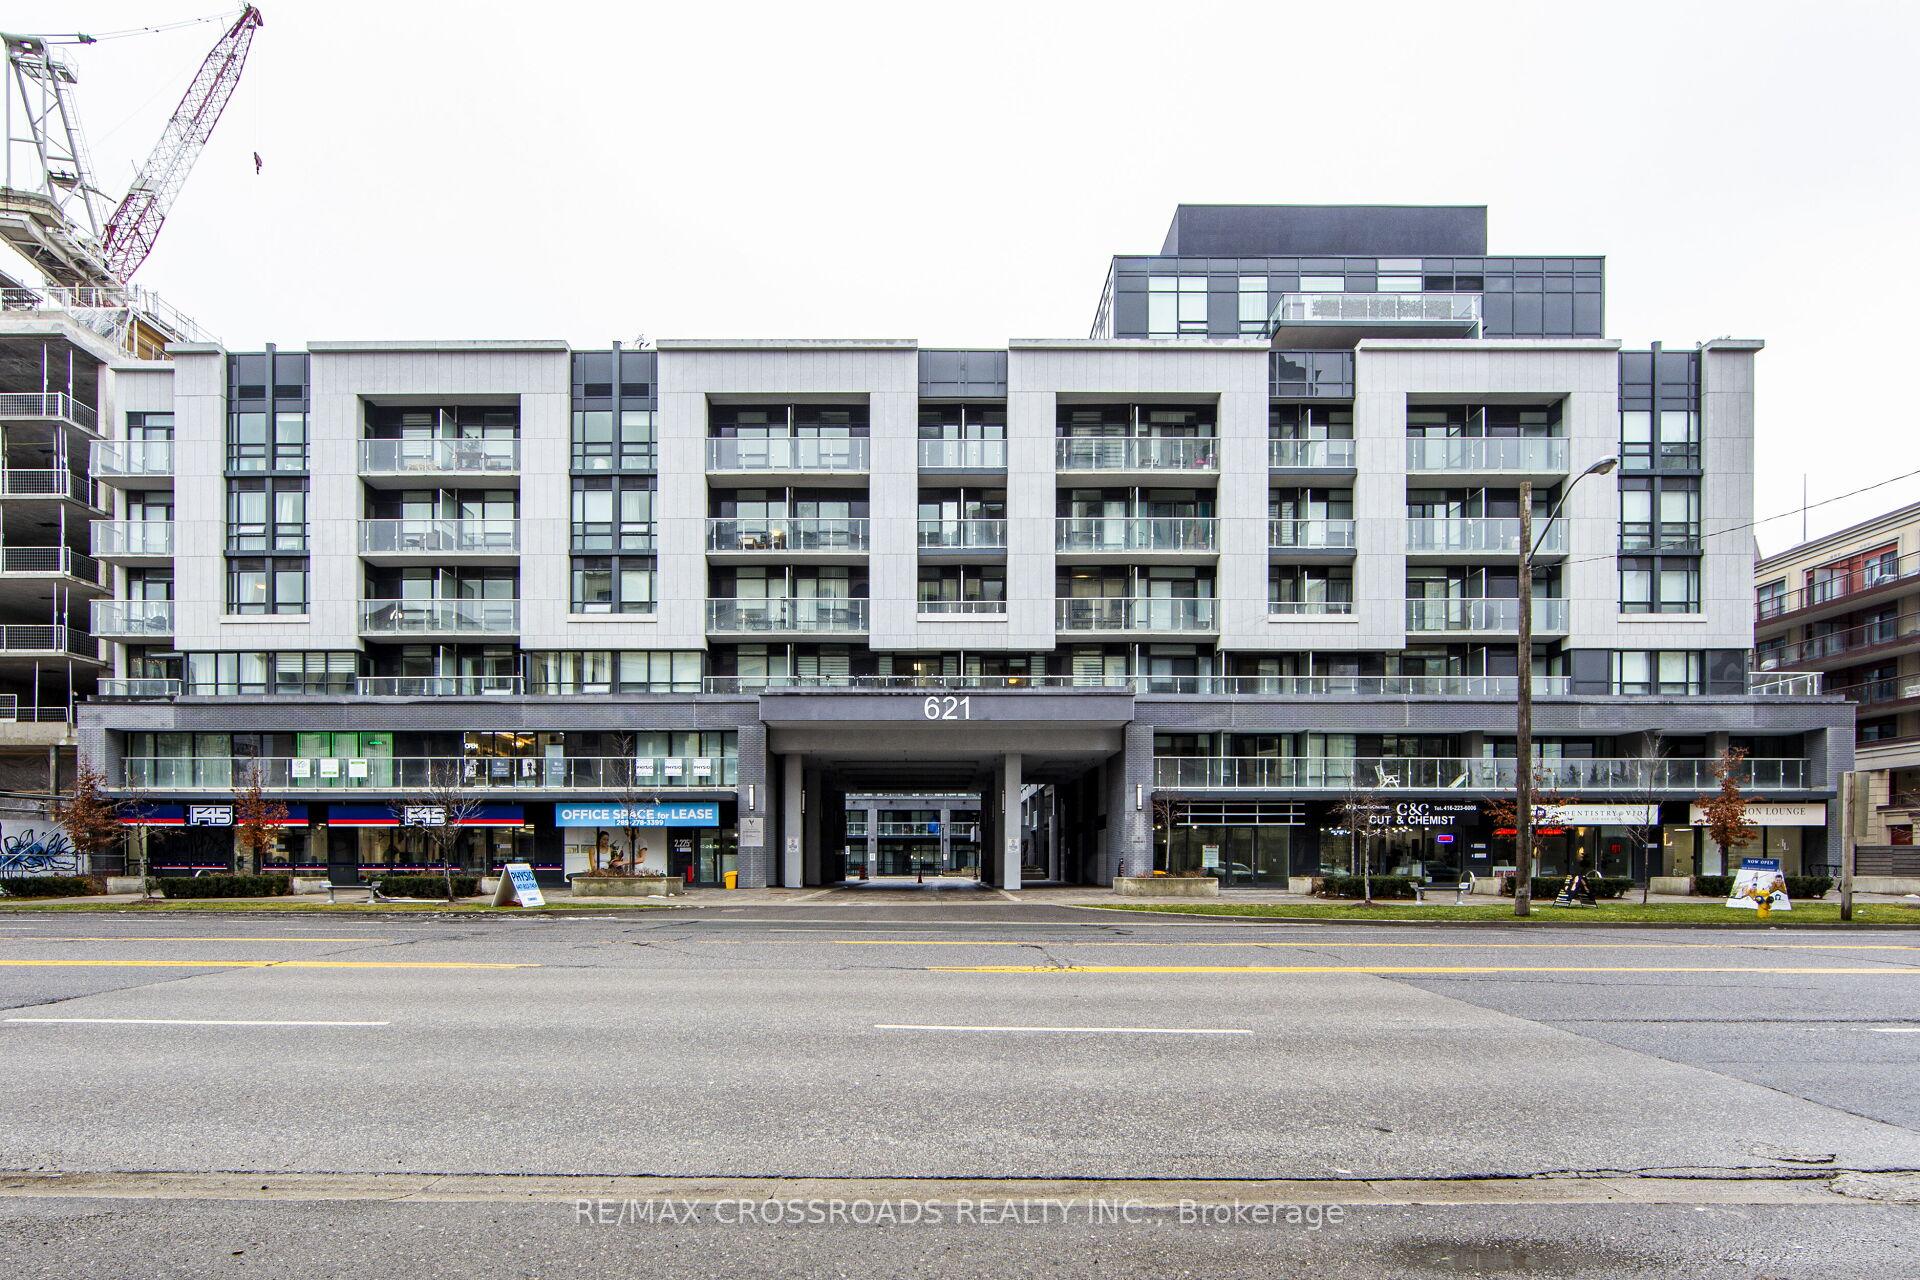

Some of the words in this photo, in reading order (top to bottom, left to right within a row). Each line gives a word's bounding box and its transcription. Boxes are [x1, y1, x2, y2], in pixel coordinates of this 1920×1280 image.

[924, 696, 970, 720] 621
[191, 806, 232, 825] F45
[562, 809, 609, 820] OFFICE
[657, 811, 669, 819] for
[671, 809, 713, 820] LEASE
[1766, 807, 1806, 816] LOUNGE
[1370, 816, 1391, 825] CUT
[1397, 816, 1404, 825] &
[1408, 816, 1455, 825] CHEMIST
